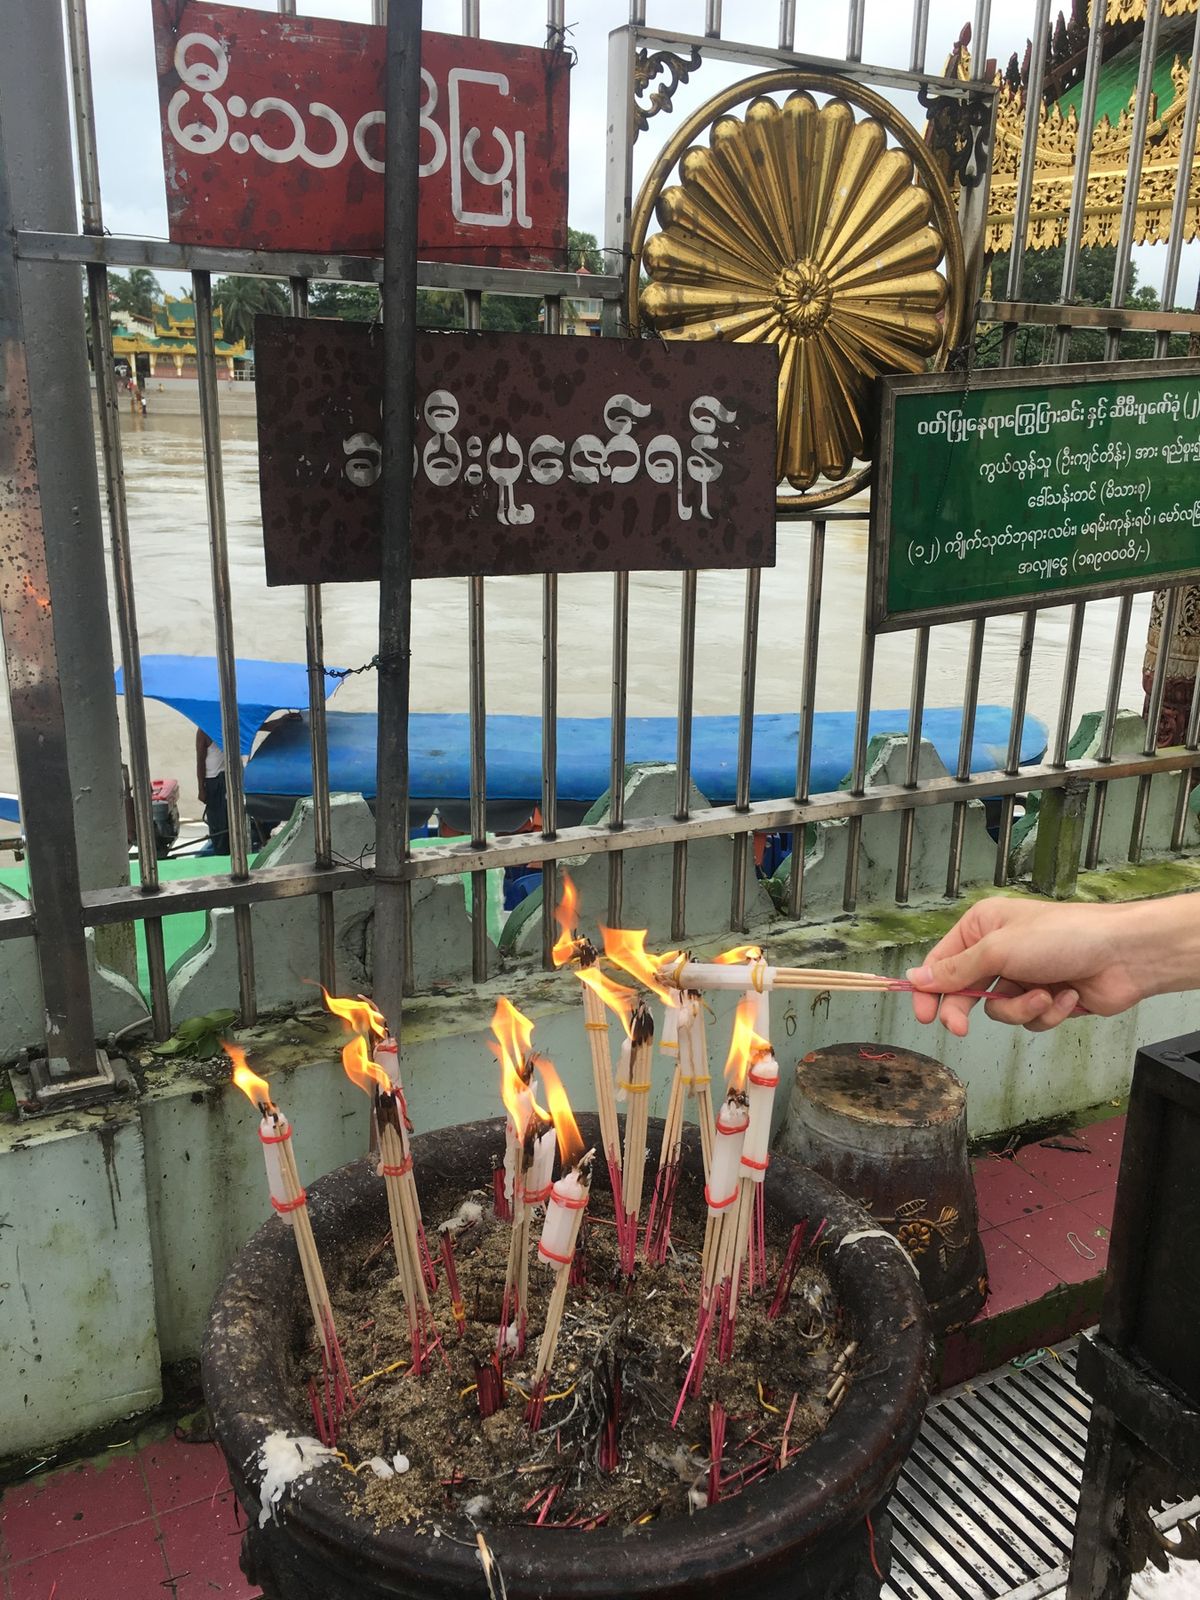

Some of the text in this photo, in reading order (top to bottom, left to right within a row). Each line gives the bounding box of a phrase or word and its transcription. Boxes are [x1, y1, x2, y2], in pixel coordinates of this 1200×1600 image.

[1088, 397, 1109, 430] နှင့်
[342, 389, 737, 526] ဆမီးပူဇော်ရန်
[980, 450, 1052, 483] ကွယ်လွန်သူ
[1135, 447, 1158, 460] အား
[1101, 476, 1151, 505] (မိသားစု)
